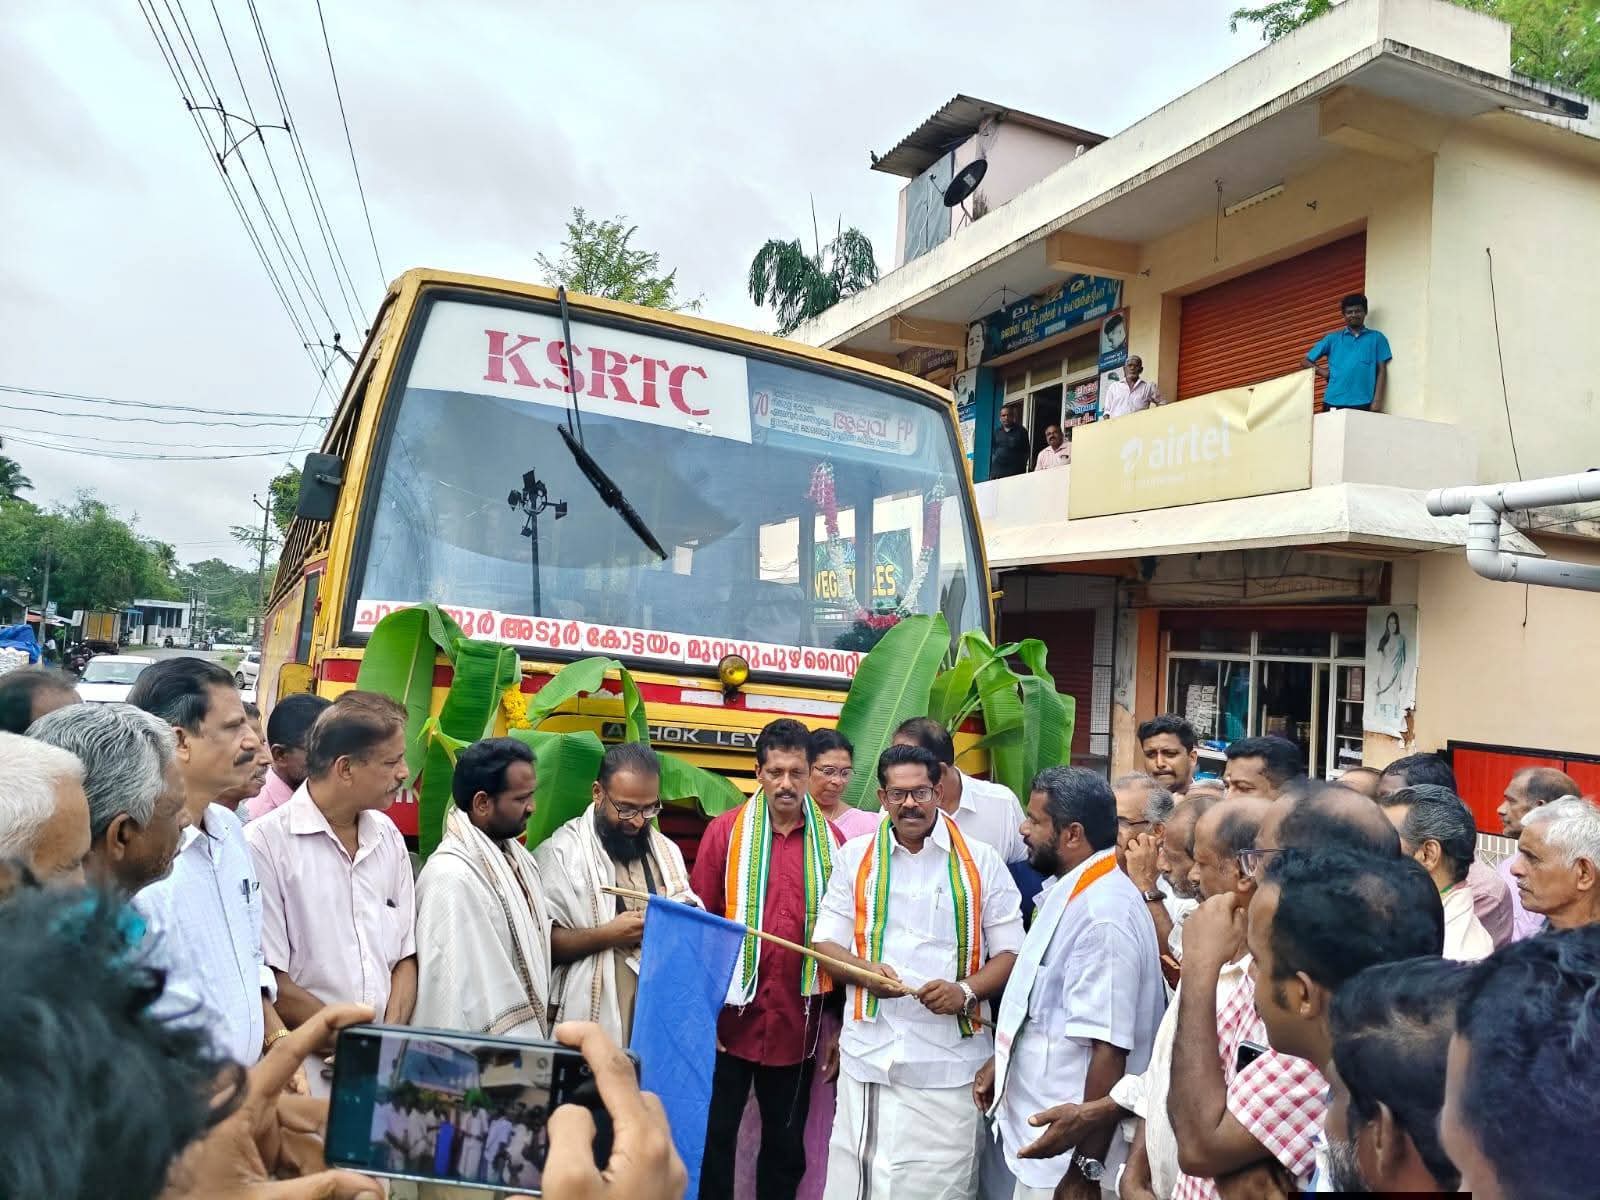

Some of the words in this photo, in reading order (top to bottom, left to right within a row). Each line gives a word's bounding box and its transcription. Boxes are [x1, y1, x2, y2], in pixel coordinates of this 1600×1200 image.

[483, 329, 710, 416] KSRTC
[1148, 416, 1232, 469] airtel
[587, 626, 681, 656] കോട്ടയം
[804, 650, 860, 678] വൈറ്റി
[607, 723, 699, 743] AHOK
[716, 731, 762, 748] LEY
